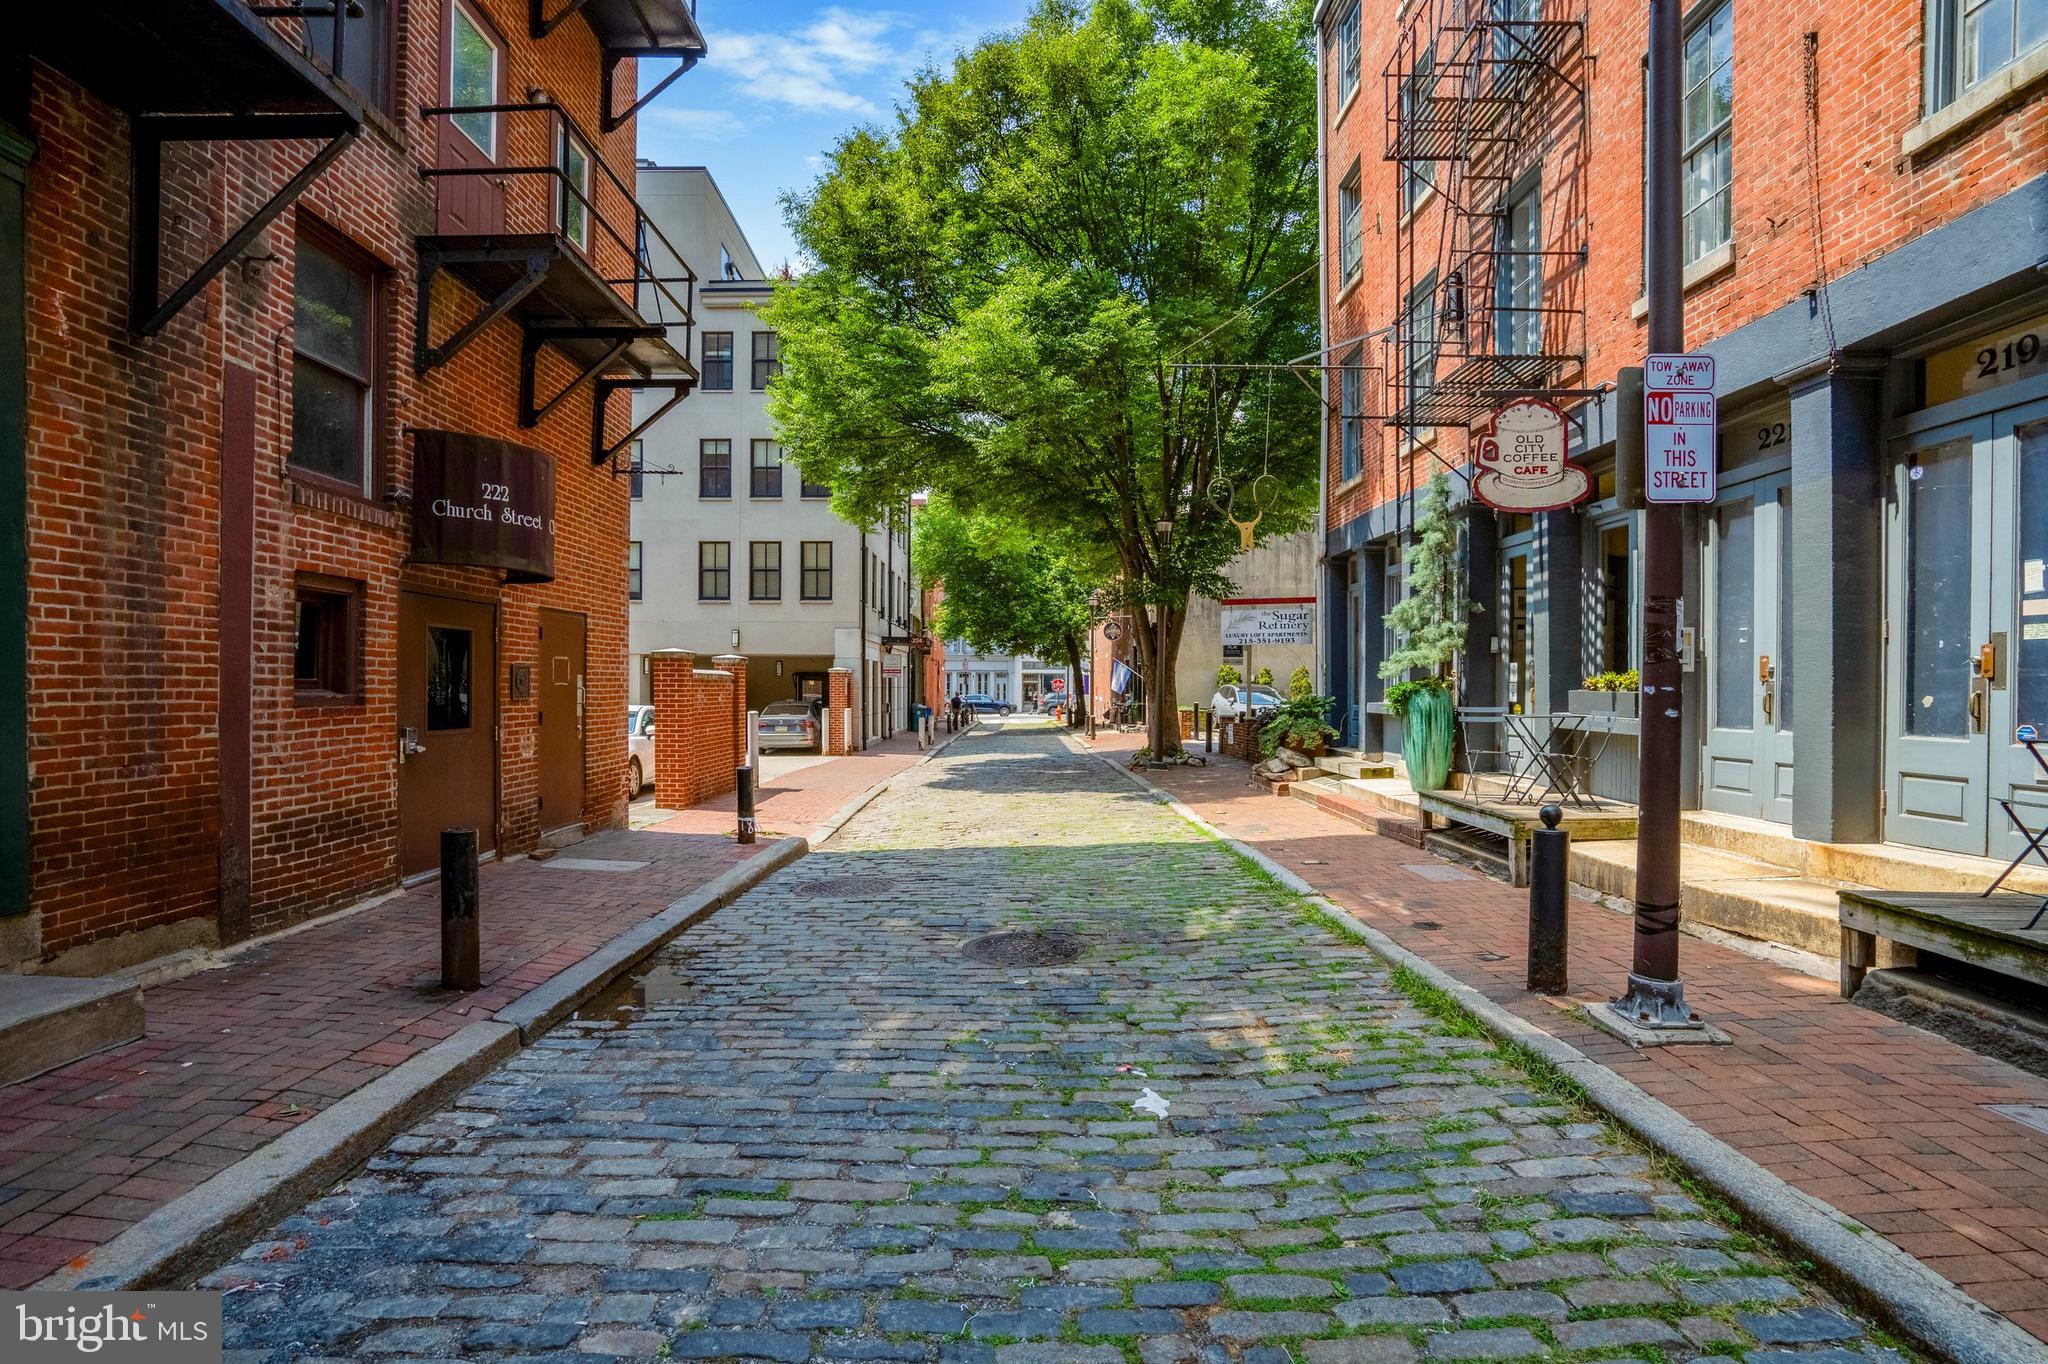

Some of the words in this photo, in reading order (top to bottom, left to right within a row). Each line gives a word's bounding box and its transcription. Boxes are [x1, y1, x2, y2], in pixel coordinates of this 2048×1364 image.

[1976, 333, 2040, 379] 219
[1667, 375, 1694, 386] ZONE
[1648, 396, 1673, 422] NO
[1675, 401, 1712, 419] PARKING
[1515, 434, 1544, 444] OLD
[1674, 433, 1686, 446] IN
[1514, 444, 1545, 453] CITY
[1503, 453, 1558, 463] COFFEE
[1663, 450, 1697, 467] THIS
[1513, 466, 1549, 475] CAFE
[1653, 471, 1708, 489] STREET
[481, 483, 510, 502] 222
[432, 499, 493, 521] Church
[501, 507, 543, 530] Street
[1272, 611, 1309, 623] Sugar
[1259, 621, 1309, 632] Refinery
